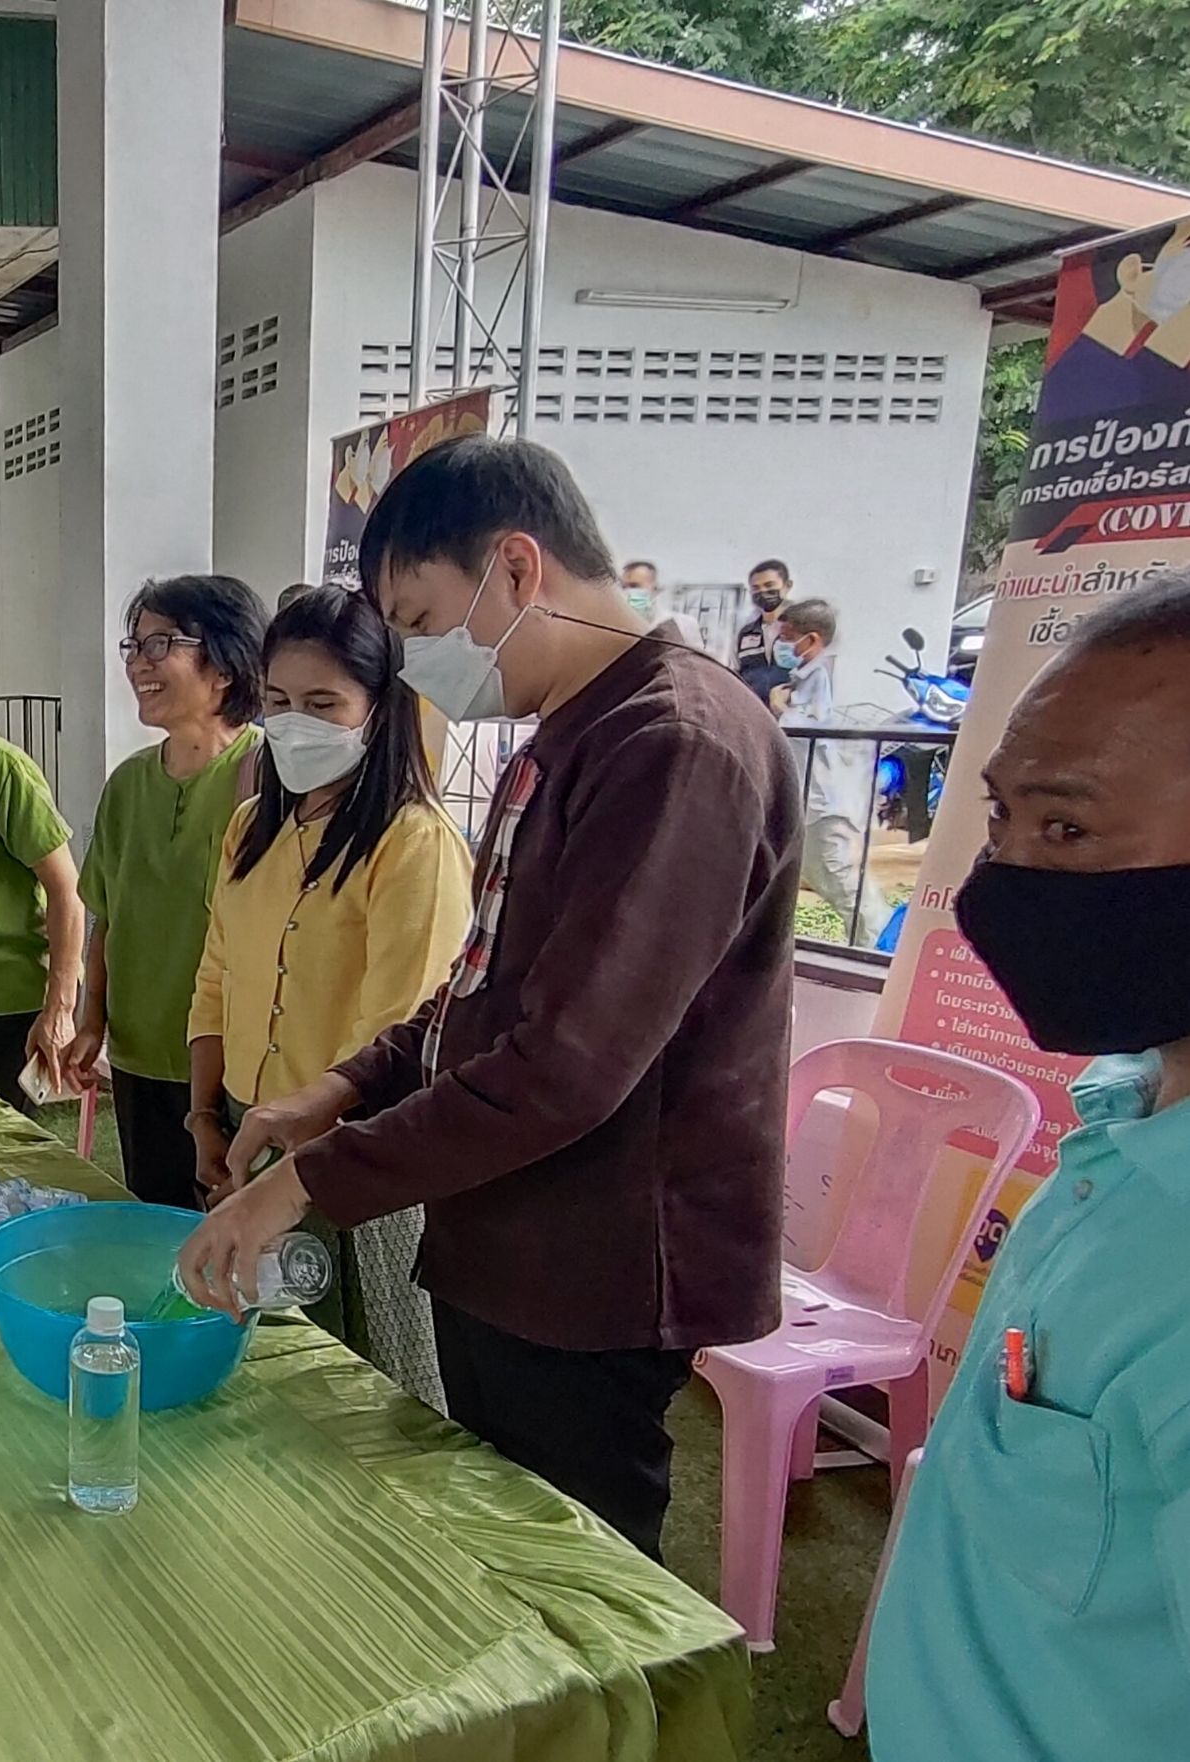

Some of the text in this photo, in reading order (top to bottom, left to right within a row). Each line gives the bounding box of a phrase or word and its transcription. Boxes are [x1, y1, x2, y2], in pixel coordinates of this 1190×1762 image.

[1029, 408, 1190, 471] การป้องก
[1019, 460, 1190, 506] การติดเชื้อไวรัส
